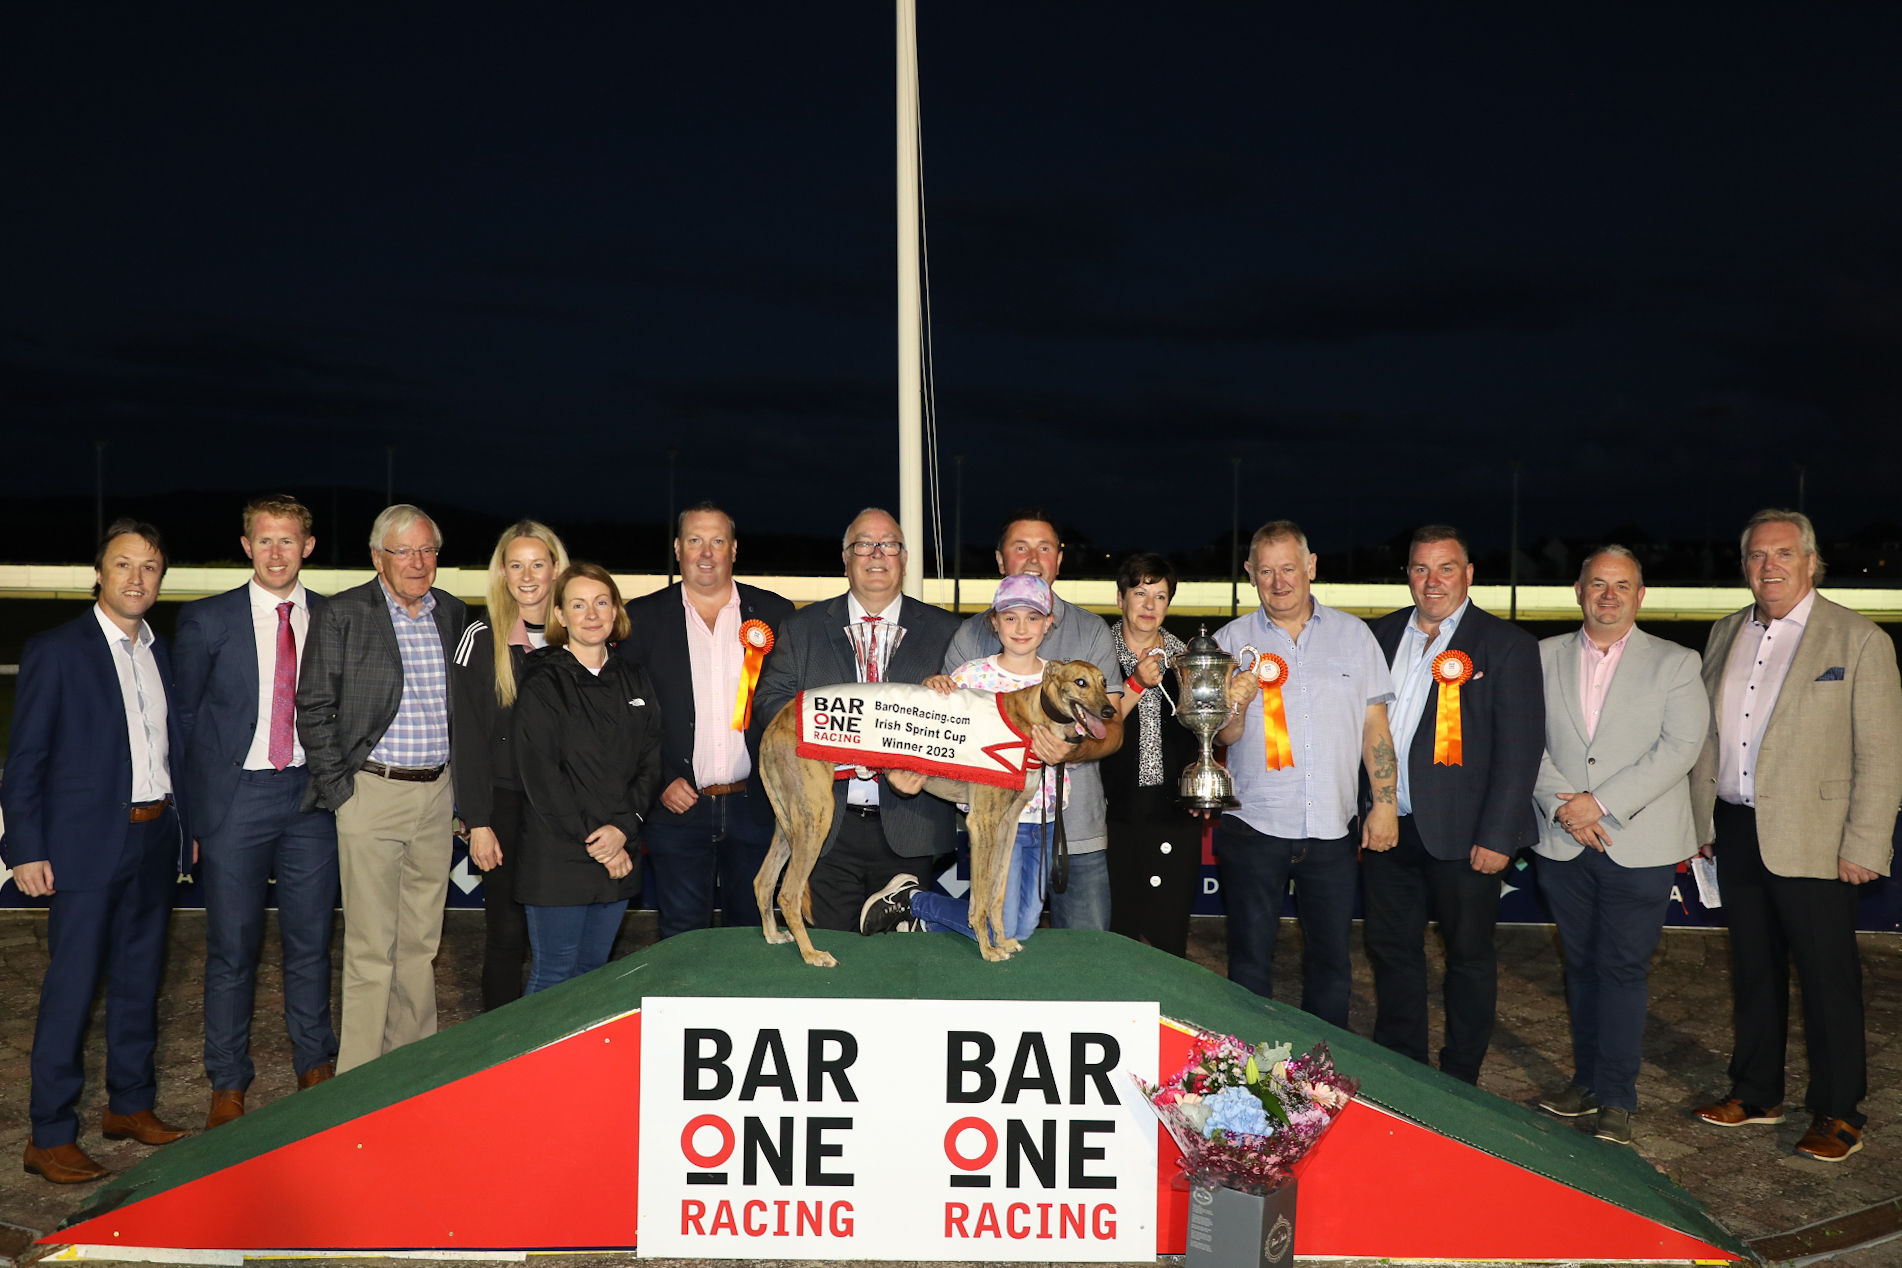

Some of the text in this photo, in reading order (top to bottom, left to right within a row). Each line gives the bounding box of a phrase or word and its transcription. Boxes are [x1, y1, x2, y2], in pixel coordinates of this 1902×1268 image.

[814, 697, 864, 715] BAR
[875, 701, 971, 725] BarOneRacing.com
[813, 730, 861, 744] RACING
[814, 712, 862, 733] ONE
[875, 718, 967, 745] Irish Sprint Cup
[882, 736, 955, 759] Winner 2023
[683, 1028, 859, 1102] BAR
[946, 1030, 1121, 1106] BAR
[680, 1113, 855, 1186] ONE
[943, 1116, 1118, 1189] ONE
[680, 1199, 855, 1237] RACING
[943, 1202, 1118, 1240] RACING
